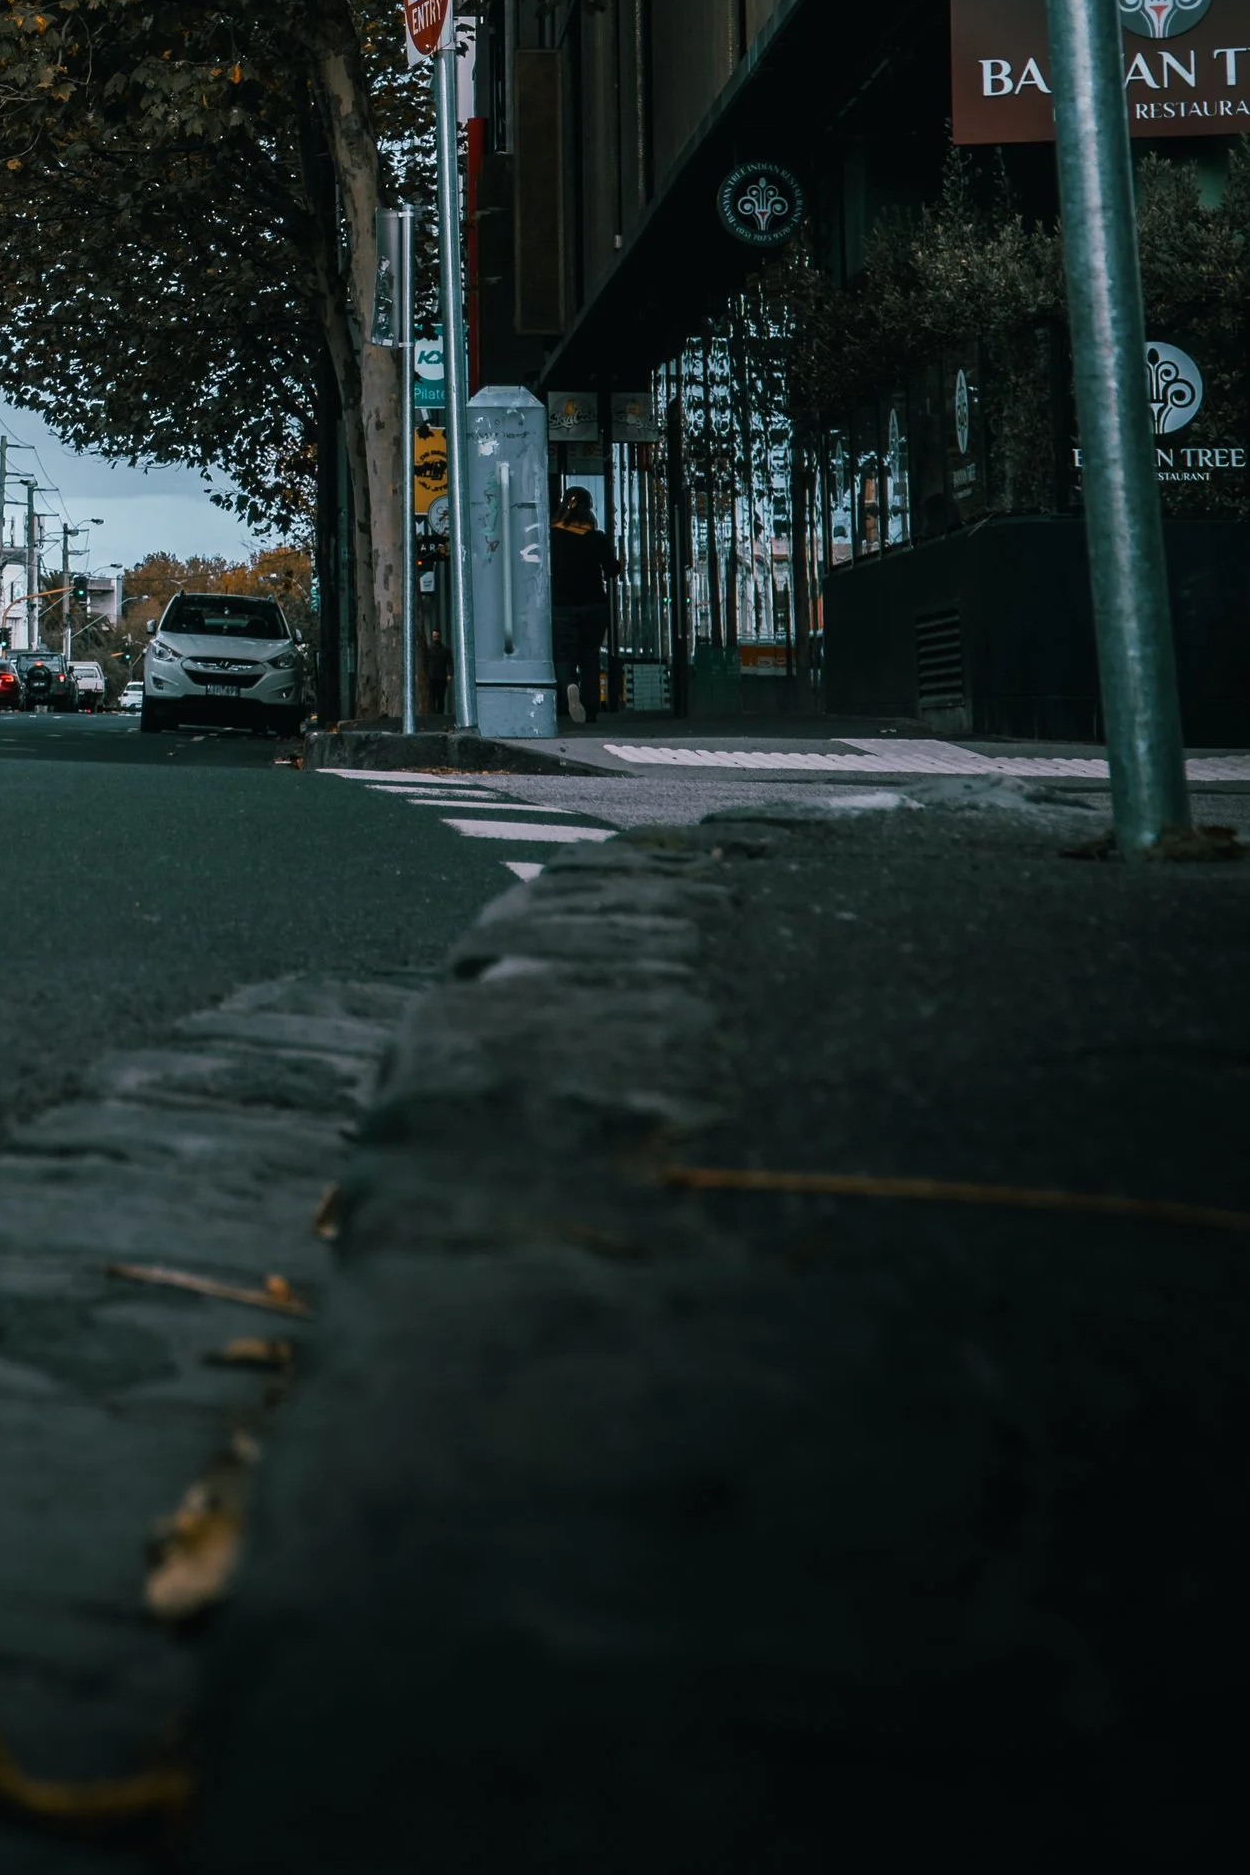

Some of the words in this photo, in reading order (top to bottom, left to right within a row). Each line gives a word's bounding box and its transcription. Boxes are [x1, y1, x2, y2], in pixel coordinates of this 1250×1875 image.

[978, 49, 1196, 97] BAAN
[728, 167, 746, 186] TREE
[746, 163, 779, 173] INDIAN
[414, 387, 446, 400] Pilate
[1180, 448, 1247, 468] TREE
[1157, 472, 1211, 481] STAURANT
